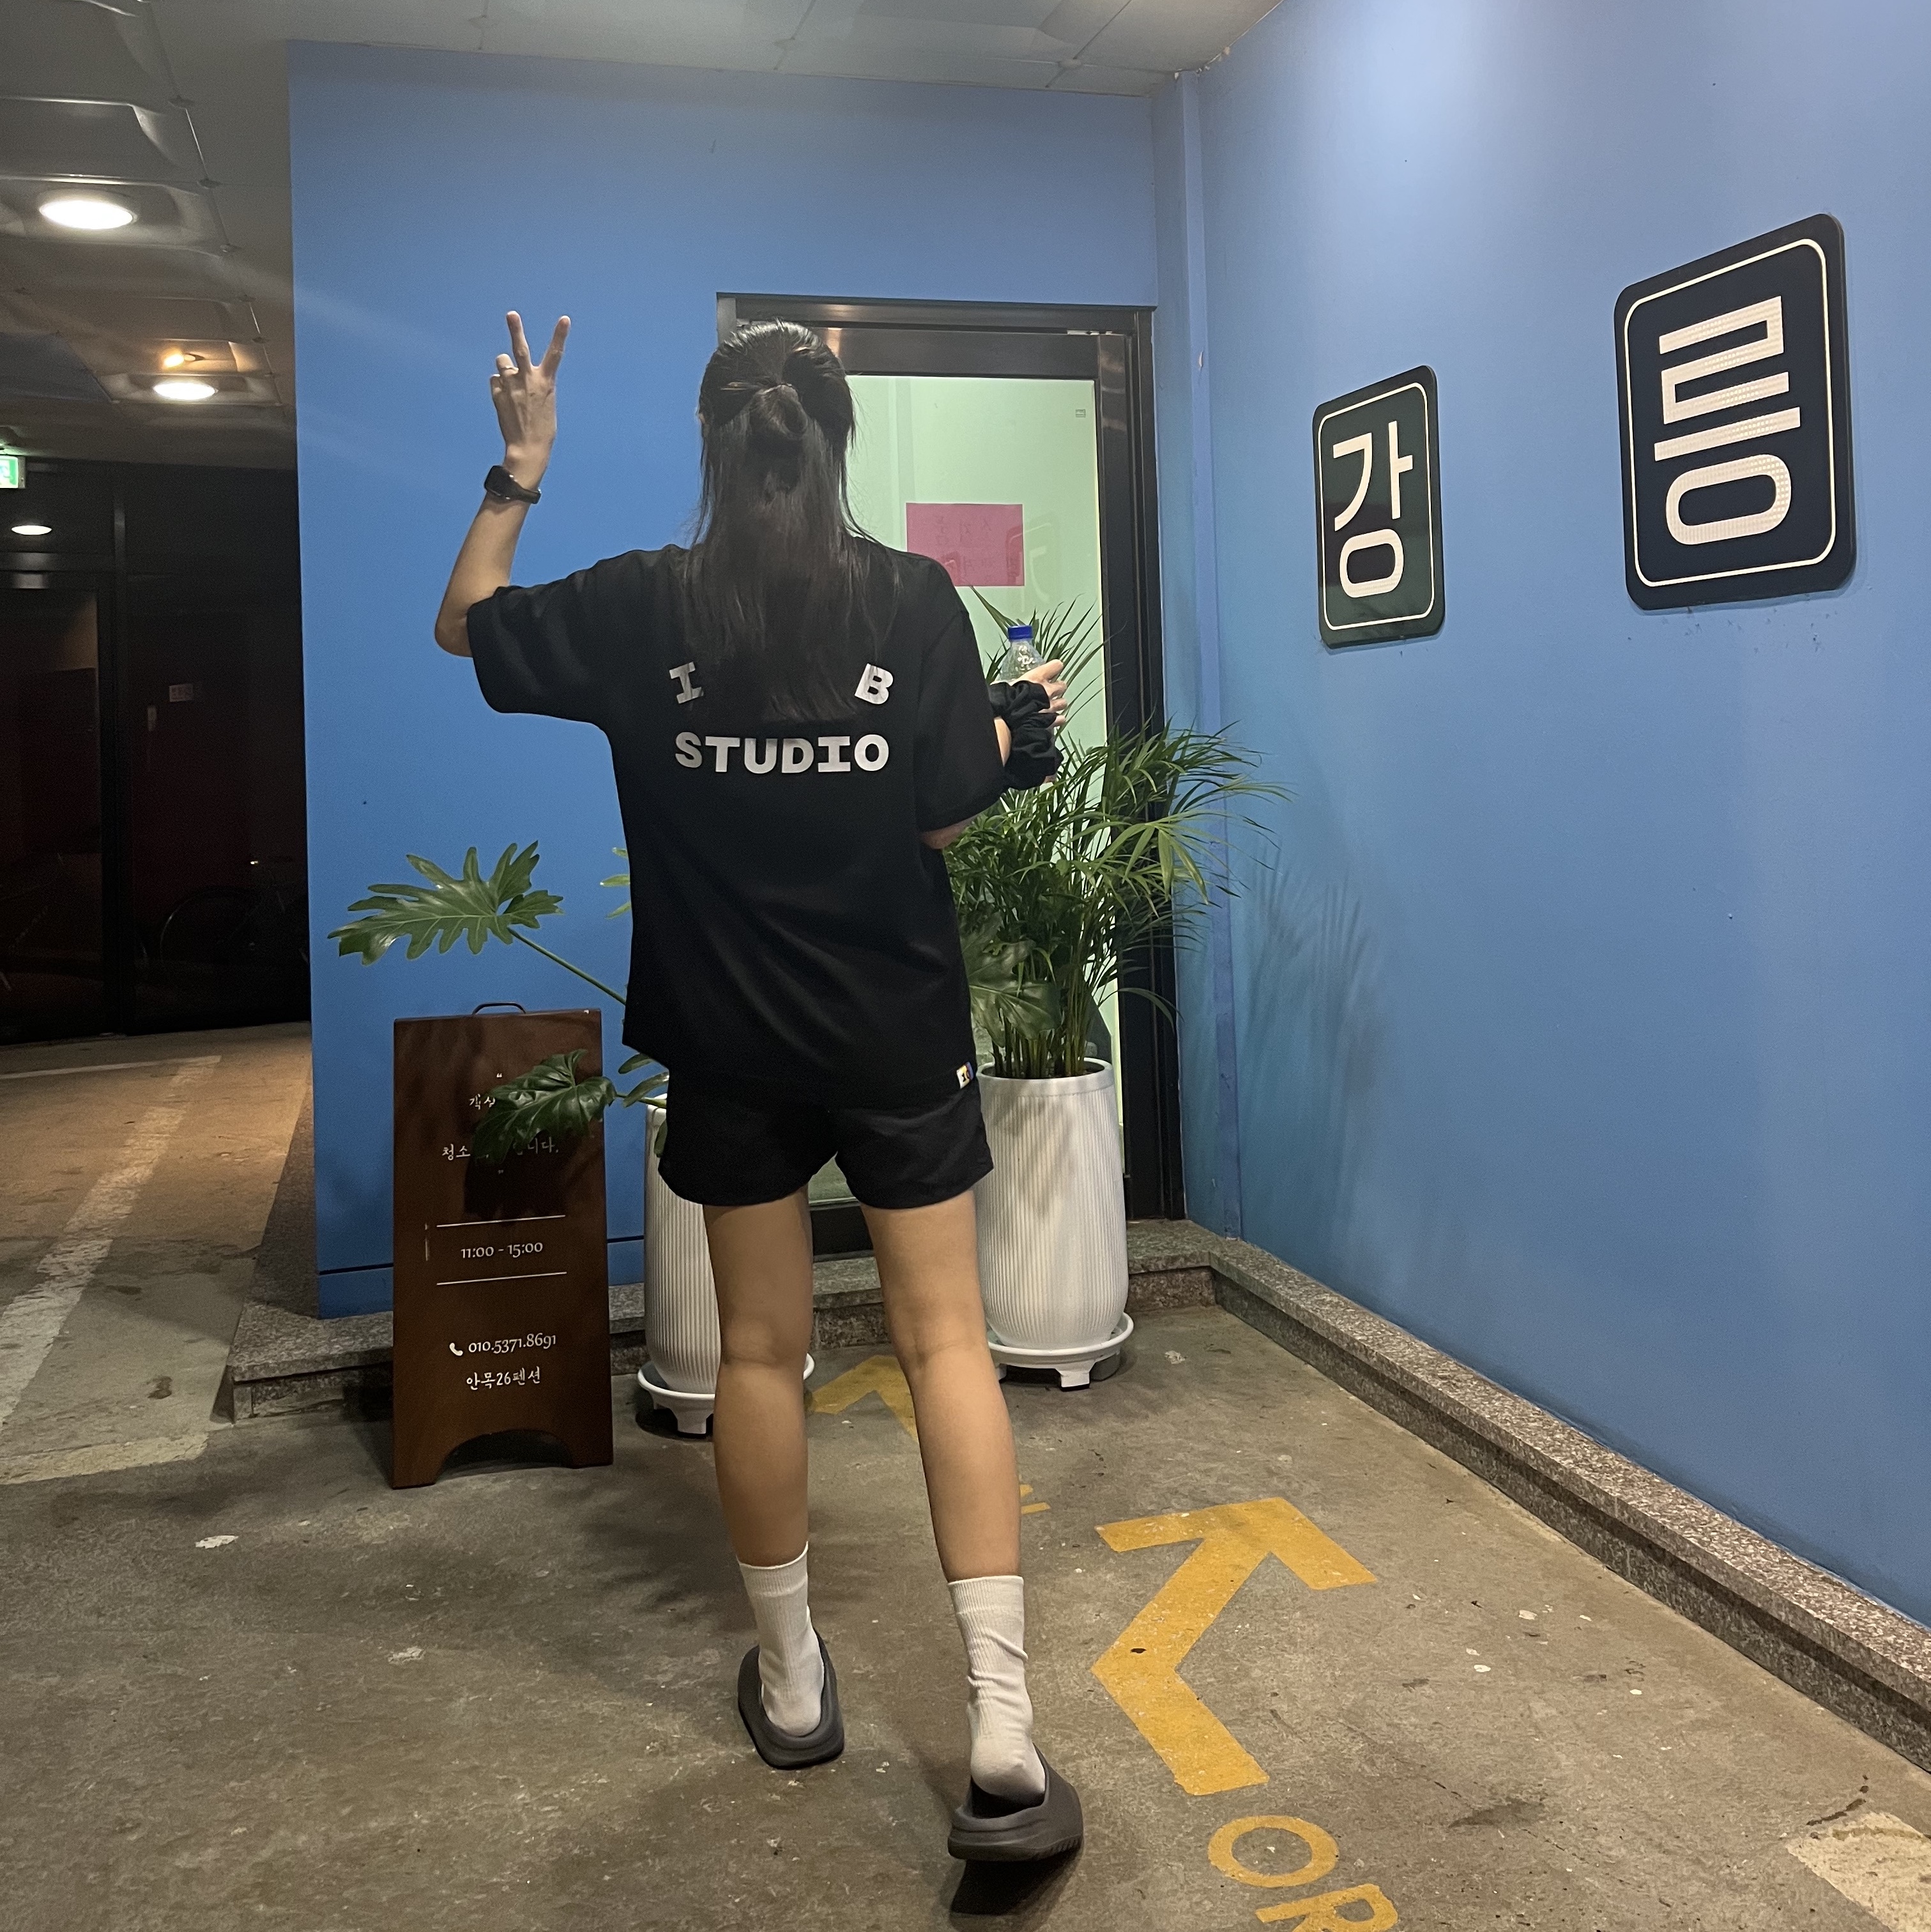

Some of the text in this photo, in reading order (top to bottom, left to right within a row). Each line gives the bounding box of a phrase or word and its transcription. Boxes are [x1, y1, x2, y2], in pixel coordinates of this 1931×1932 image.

[1653, 295, 1801, 545] 릉
[1332, 420, 1413, 598] 강
[675, 732, 889, 774] STUDIO
[461, 1246, 494, 1259] 11:00
[507, 1242, 543, 1258] 15:00
[468, 1332, 556, 1355] 010.5371.8691
[466, 1365, 541, 1391] 안목26펜션
